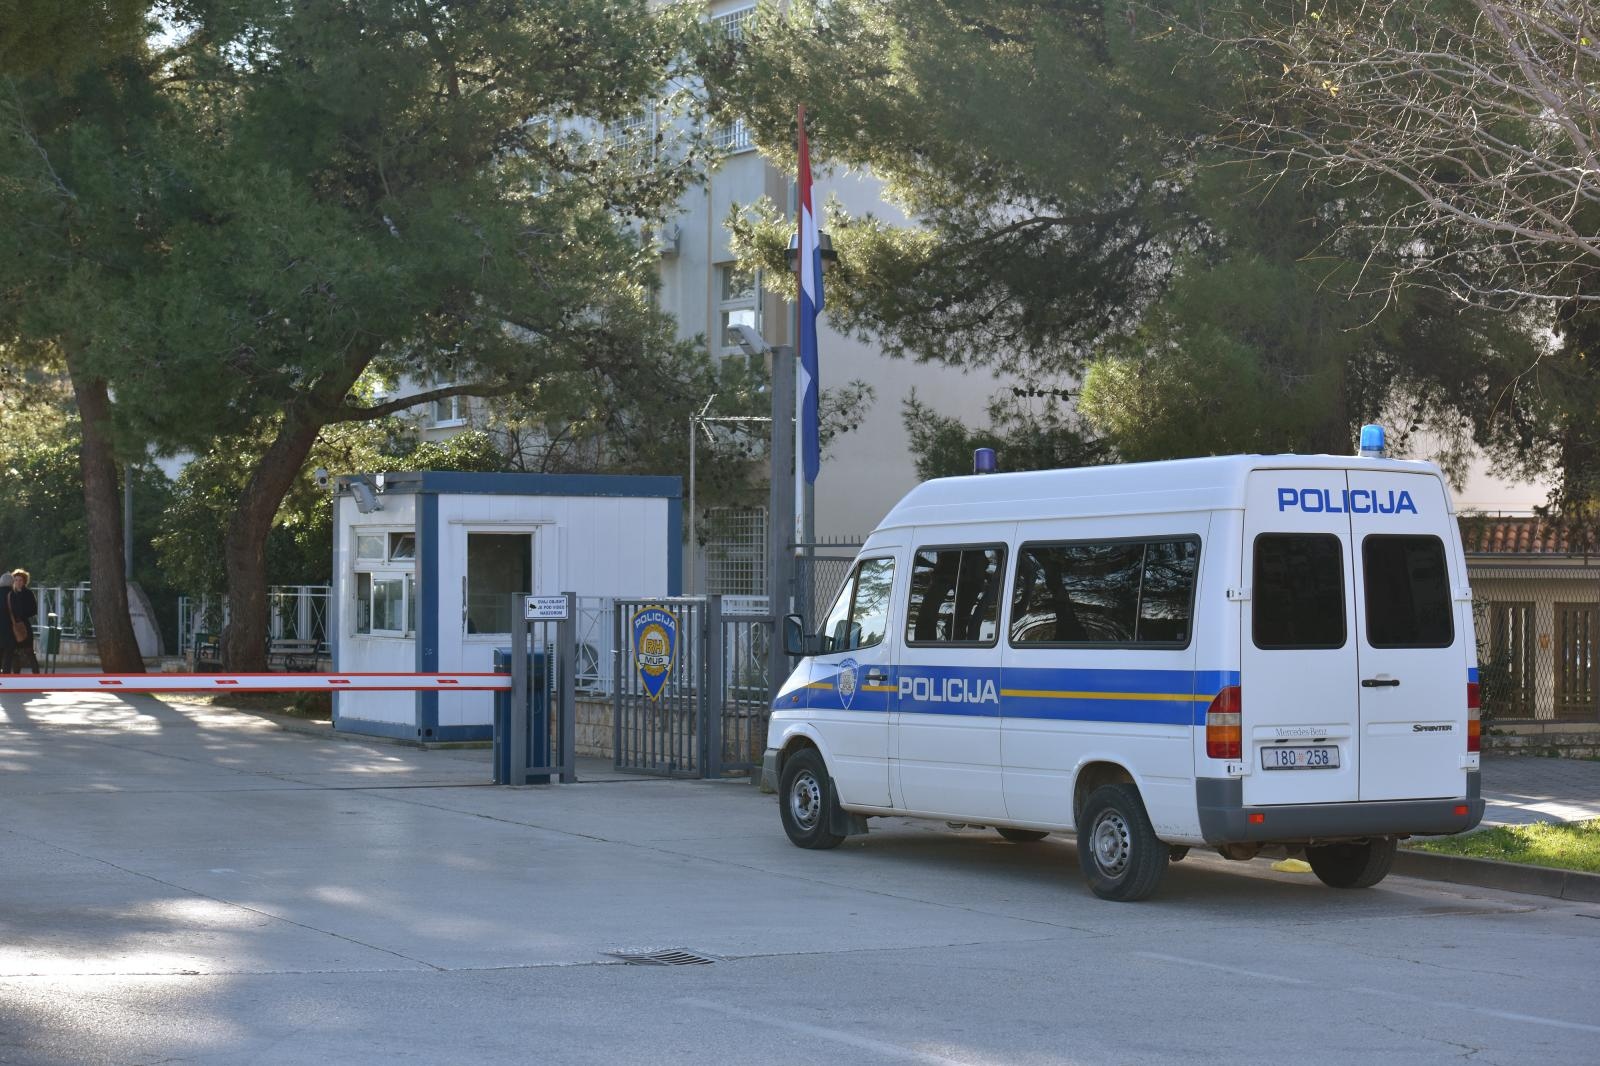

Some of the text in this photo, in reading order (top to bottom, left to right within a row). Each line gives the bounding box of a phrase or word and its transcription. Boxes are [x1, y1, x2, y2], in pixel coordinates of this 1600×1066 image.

[1277, 487, 1418, 515] POLICIJA
[635, 612, 676, 631] POLICIJA
[646, 638, 663, 655] RH
[645, 656, 664, 665] MUP
[898, 676, 999, 704] POLICIJA
[1275, 750, 1329, 766] 180 258
